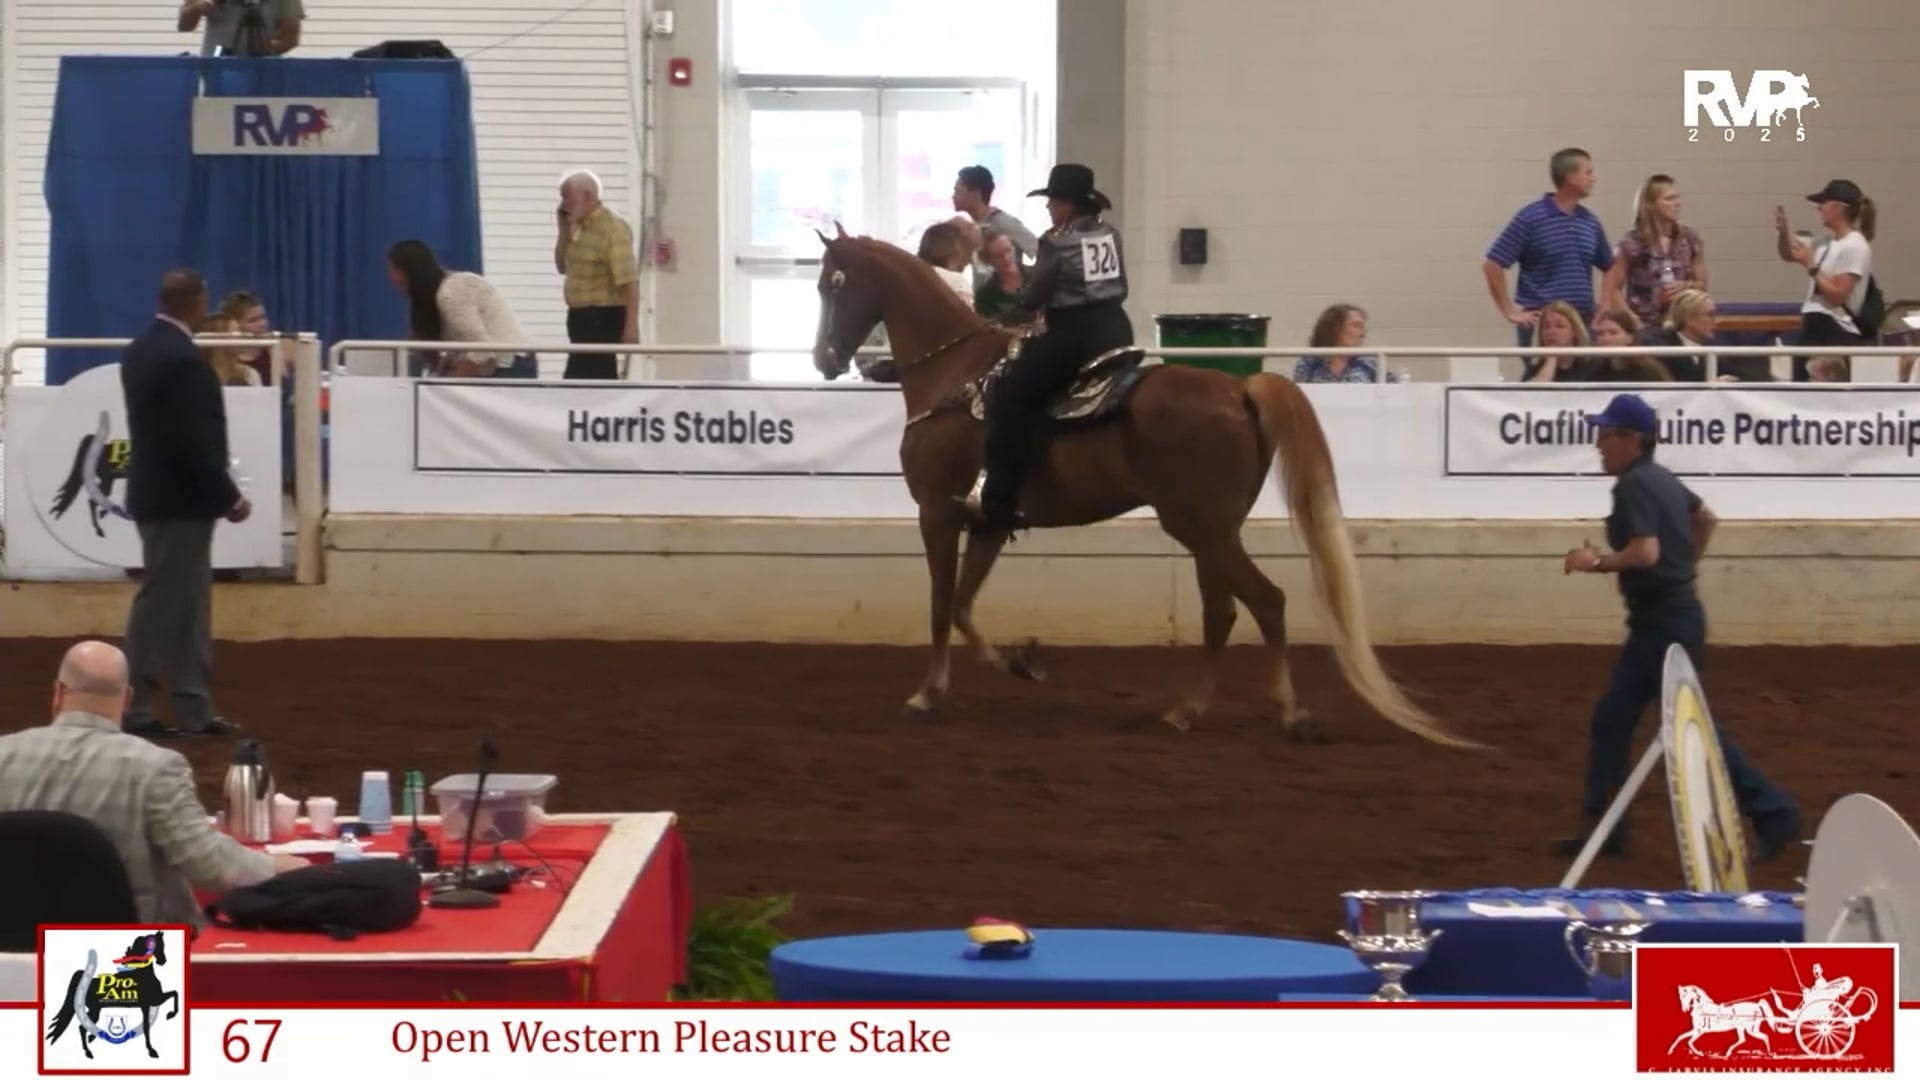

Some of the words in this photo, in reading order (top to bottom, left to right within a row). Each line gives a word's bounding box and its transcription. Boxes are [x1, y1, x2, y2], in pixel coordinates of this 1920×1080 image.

[233, 104, 318, 147] RVP
[567, 406, 666, 443] Harris
[673, 410, 795, 445] Stables
[1655, 409, 1725, 445] uine
[1734, 409, 1920, 458] Partnership
